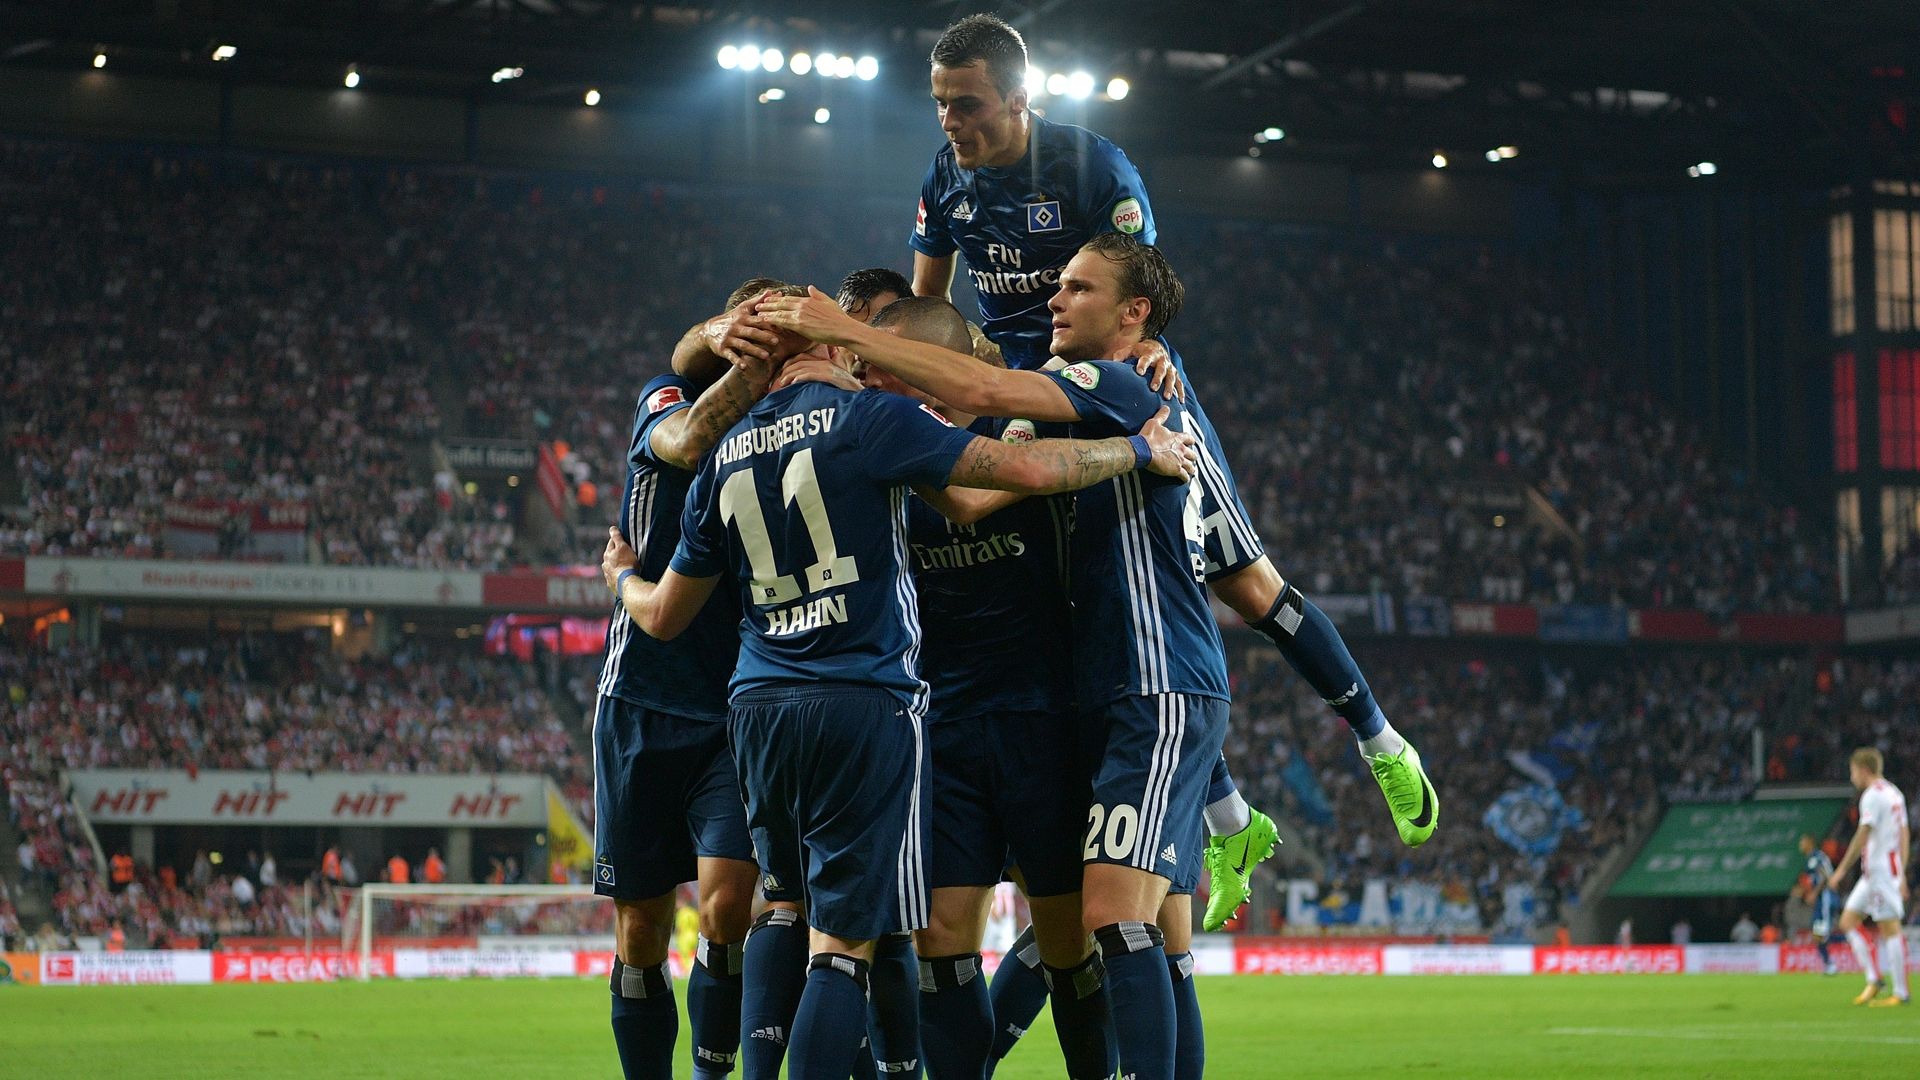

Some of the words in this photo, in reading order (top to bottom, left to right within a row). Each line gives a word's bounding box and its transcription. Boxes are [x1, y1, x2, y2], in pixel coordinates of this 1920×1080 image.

[988, 243, 1022, 268] Fly
[968, 264, 1067, 294] mirate
[808, 408, 835, 436] SV
[1004, 429, 1034, 442] popp
[719, 447, 860, 605] 11
[911, 532, 1026, 570] Emirats
[764, 594, 849, 636] HAHN
[91, 788, 168, 814] HIT
[212, 789, 290, 815] HIT
[331, 790, 407, 817] HIT
[448, 791, 523, 818] HIT
[1083, 803, 1138, 861] 20
[250, 956, 387, 983] PEGASS
[1262, 952, 1378, 974] PEGASUS
[1562, 951, 1681, 973] PEGASUS
[698, 1046, 737, 1064] HSV
[876, 1058, 918, 1073] HSV
